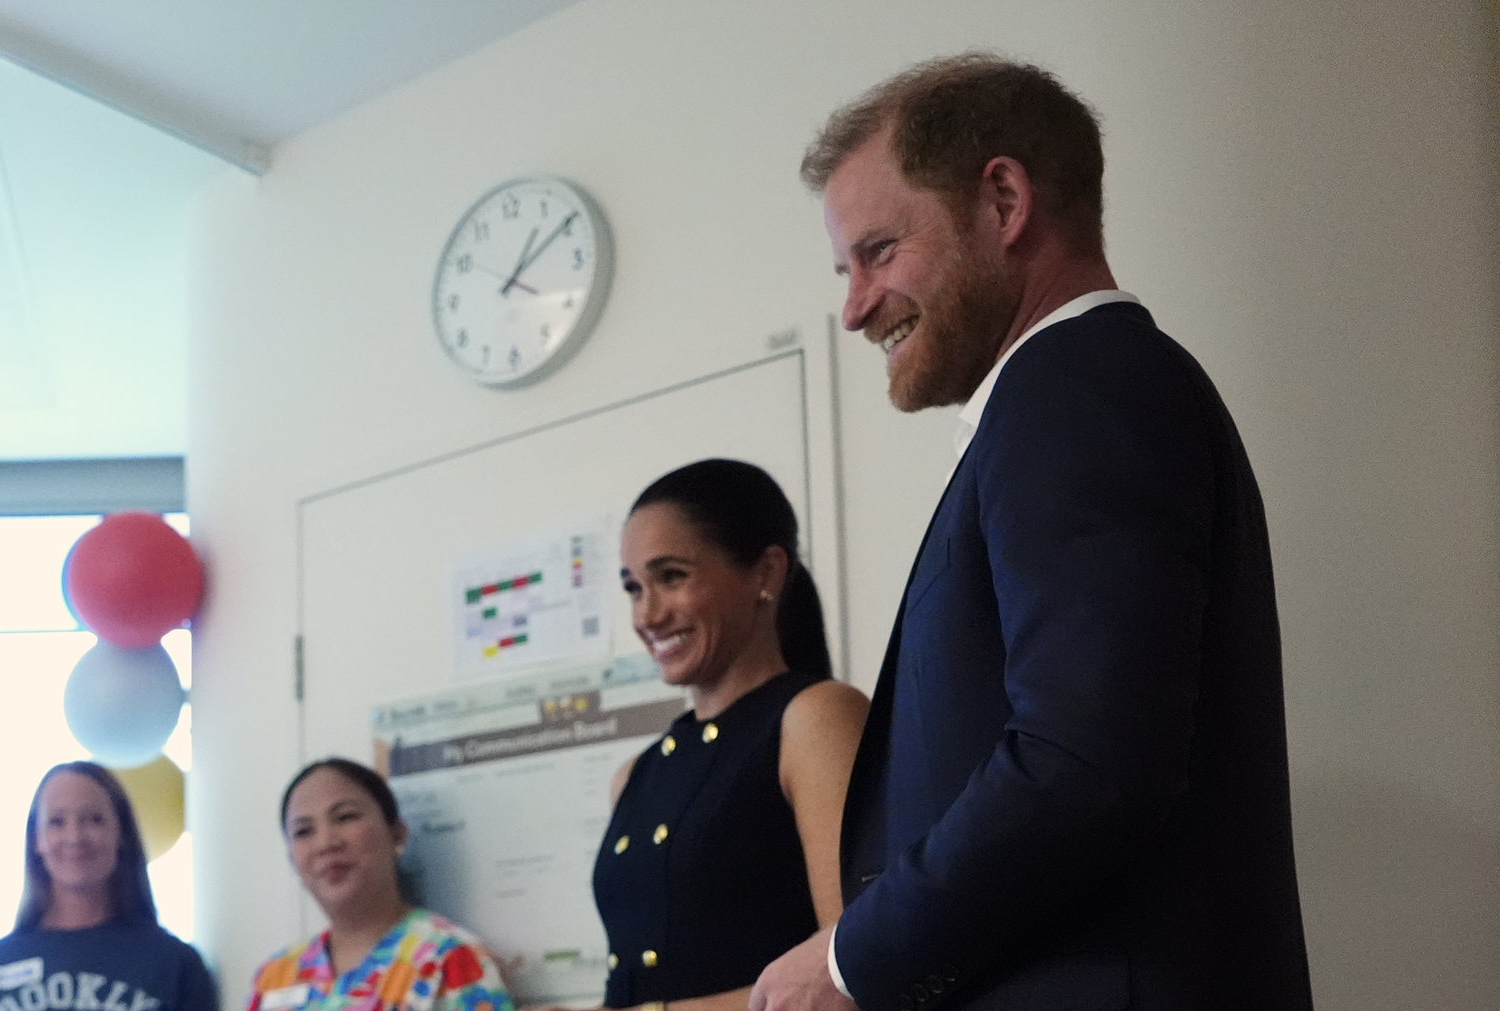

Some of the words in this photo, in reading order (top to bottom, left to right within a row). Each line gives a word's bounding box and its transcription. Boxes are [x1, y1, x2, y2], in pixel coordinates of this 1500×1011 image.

[502, 196, 520, 220] 12
[540, 200, 548, 219] 1
[474, 219, 490, 243] 11
[456, 252, 473, 274] 10
[572, 247, 584, 271] 3
[448, 293, 460, 314] 9
[457, 327, 469, 349] 8
[482, 344, 491, 365] 7
[508, 345, 521, 370] 6
